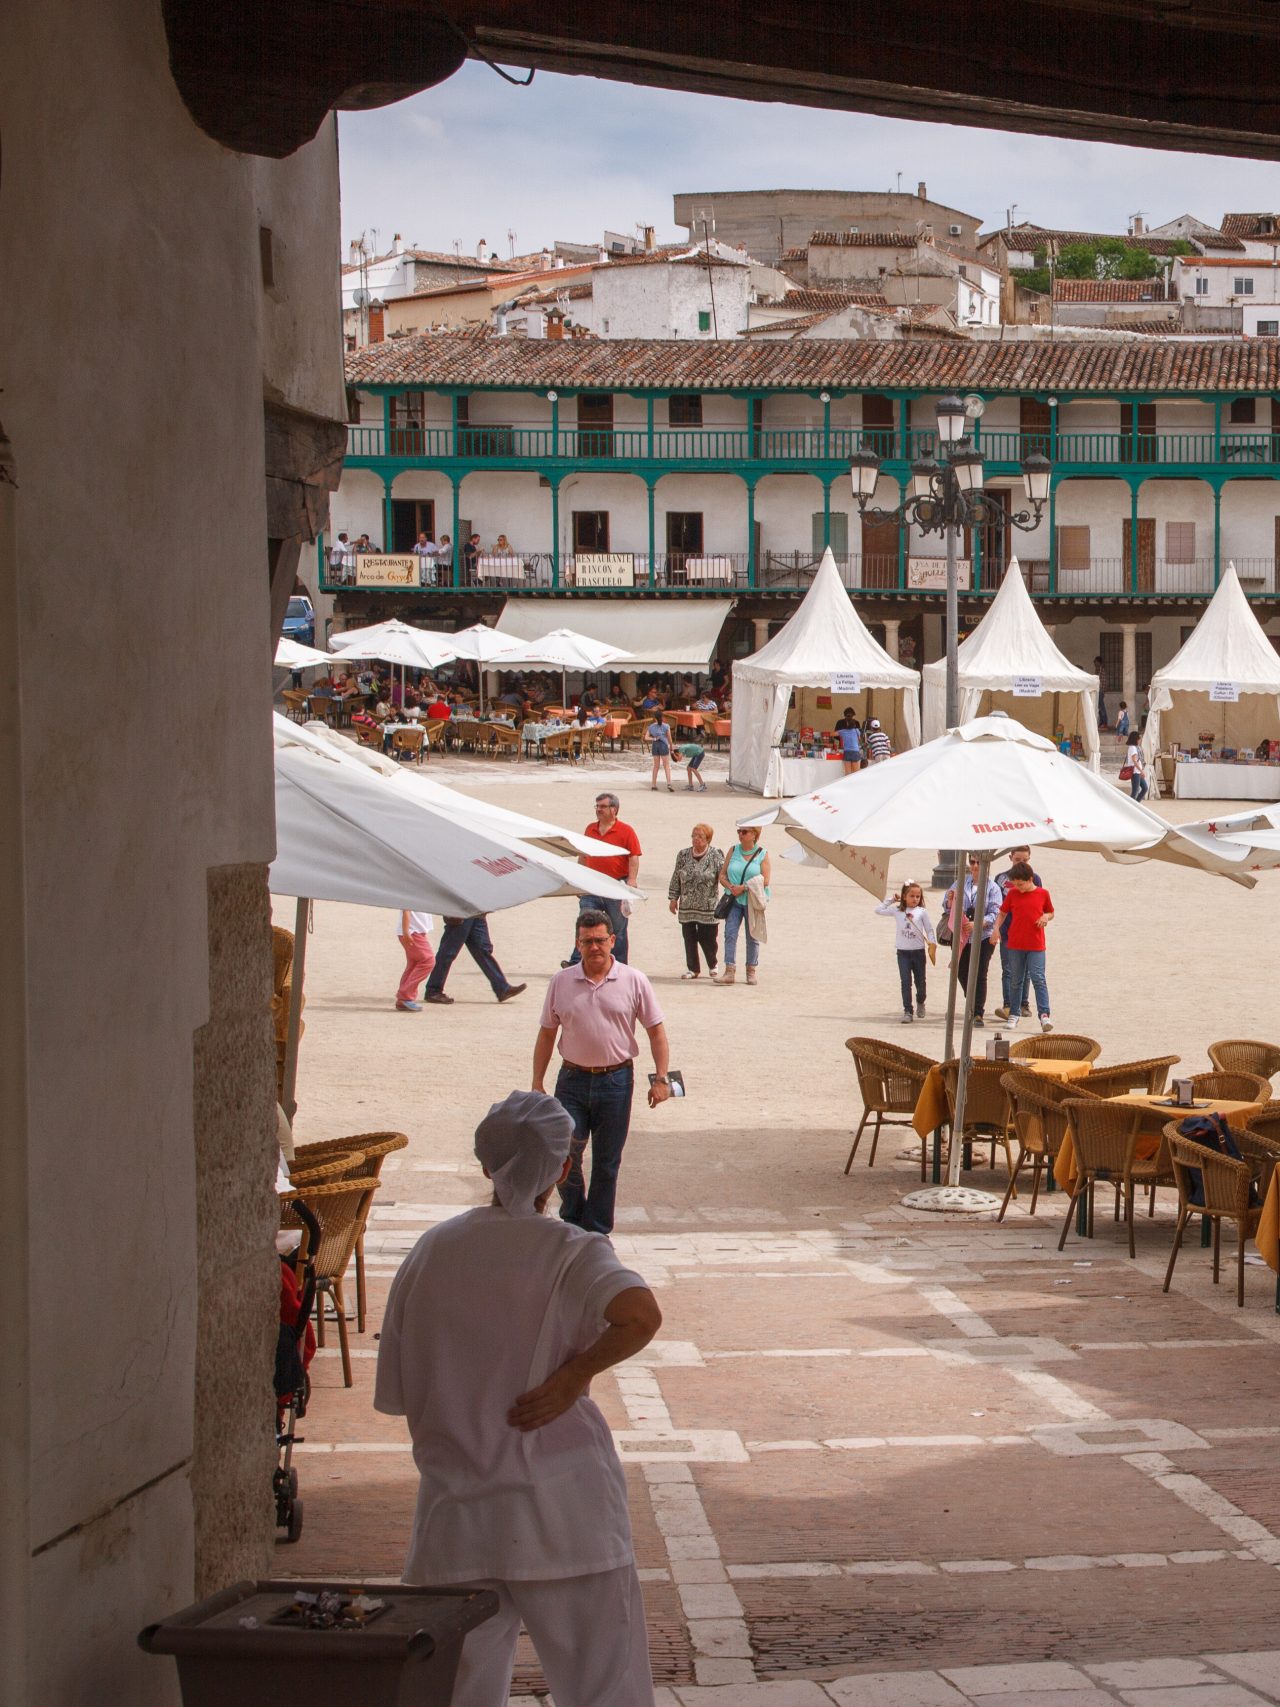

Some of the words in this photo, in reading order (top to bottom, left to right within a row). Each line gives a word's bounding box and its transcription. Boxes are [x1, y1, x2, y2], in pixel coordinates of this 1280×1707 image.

[576, 553, 632, 563] RESTAURANTE
[360, 570, 375, 580] Arco
[375, 570, 385, 580] de
[576, 577, 622, 586] FRASCUELO
[971, 821, 1036, 834] Mahou
